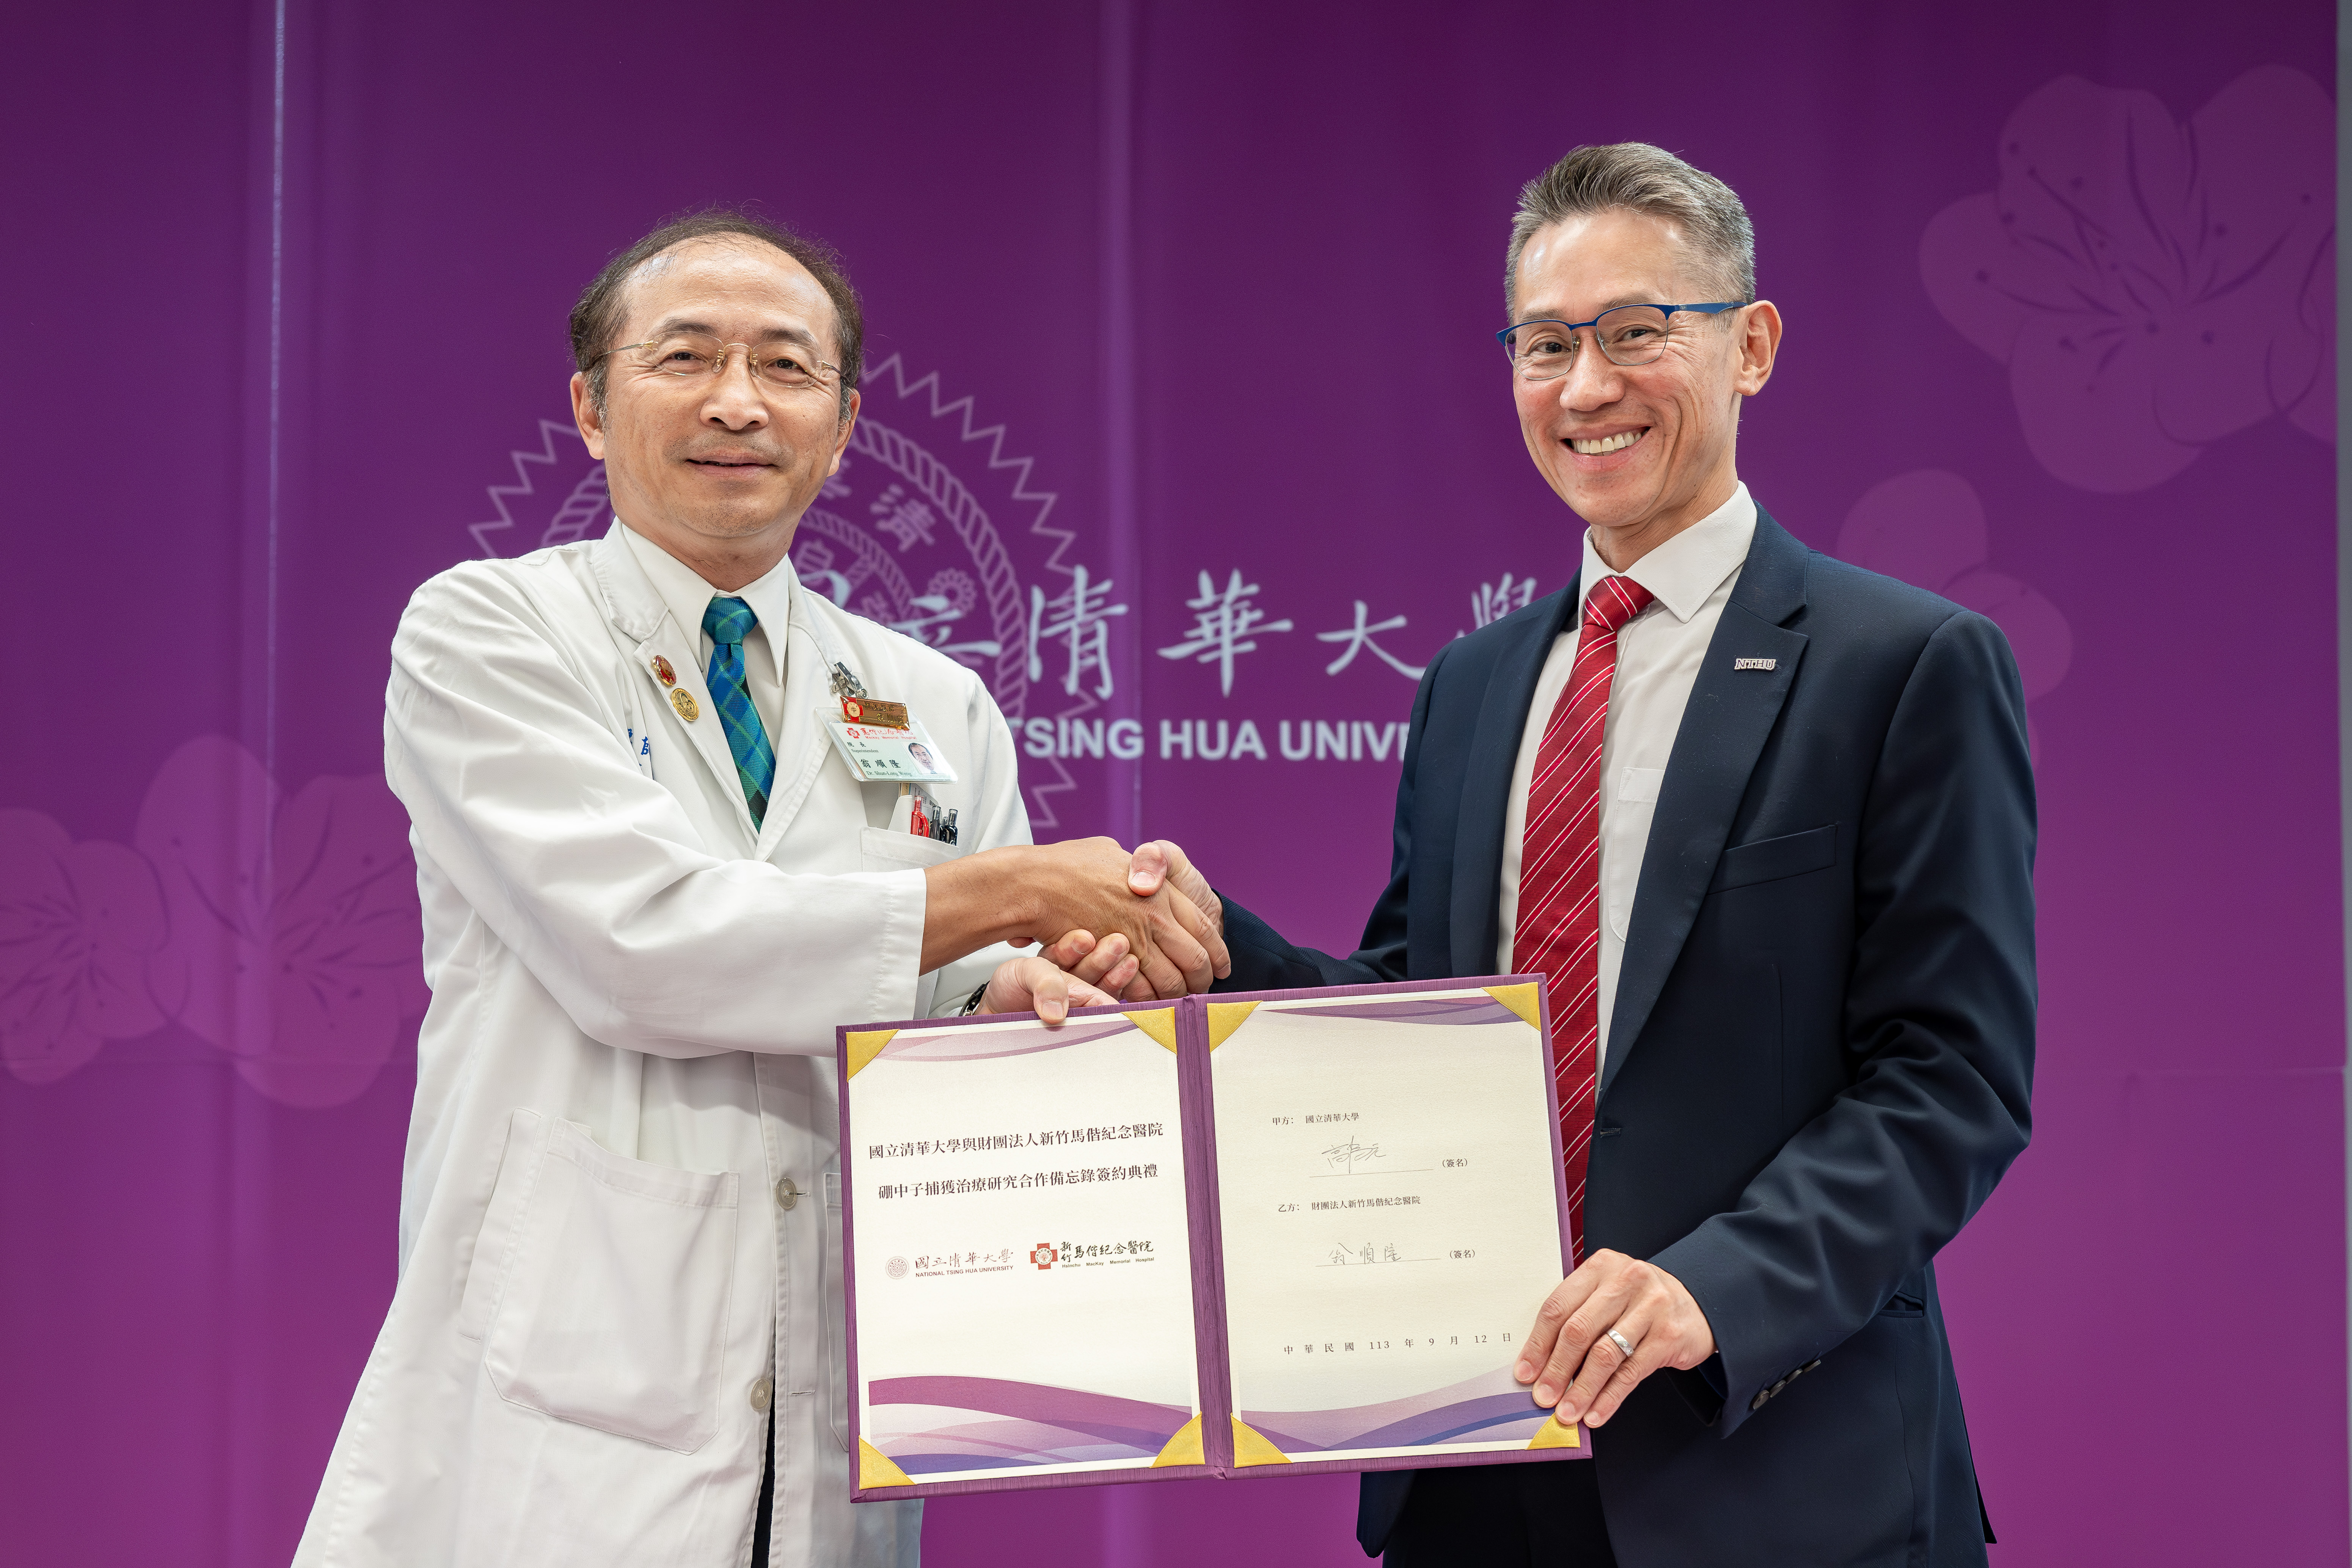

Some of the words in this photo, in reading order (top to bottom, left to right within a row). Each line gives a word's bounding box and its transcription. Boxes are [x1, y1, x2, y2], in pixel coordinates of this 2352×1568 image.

[796, 565, 1537, 700] 立清華大
[1734, 658, 1776, 670] NTHU
[1159, 719, 1266, 760] HUA
[860, 759, 901, 768] 翁順隆
[1305, 1112, 1359, 1124] 國立清華大學
[869, 1122, 1163, 1160] 國立清華大學與財團法人新竹馬偕紀念醫院
[878, 1163, 1158, 1199] 硼中子捕獲治療研究合作備忘錄簽約典禮
[1311, 1195, 1421, 1210] 財團法人新竹馬偕紀念醫院
[915, 1249, 1013, 1269] 國立清華大學
[1060, 1241, 1072, 1263] 新竹
[1074, 1240, 1154, 1259] 馬偕紀念醫院
[1369, 1340, 1390, 1350] 113
[1405, 1338, 1414, 1348] 年
[1429, 1338, 1434, 1346] 9
[1450, 1336, 1458, 1345] 月
[1474, 1335, 1487, 1343] 12
[1503, 1333, 1510, 1342] 日
